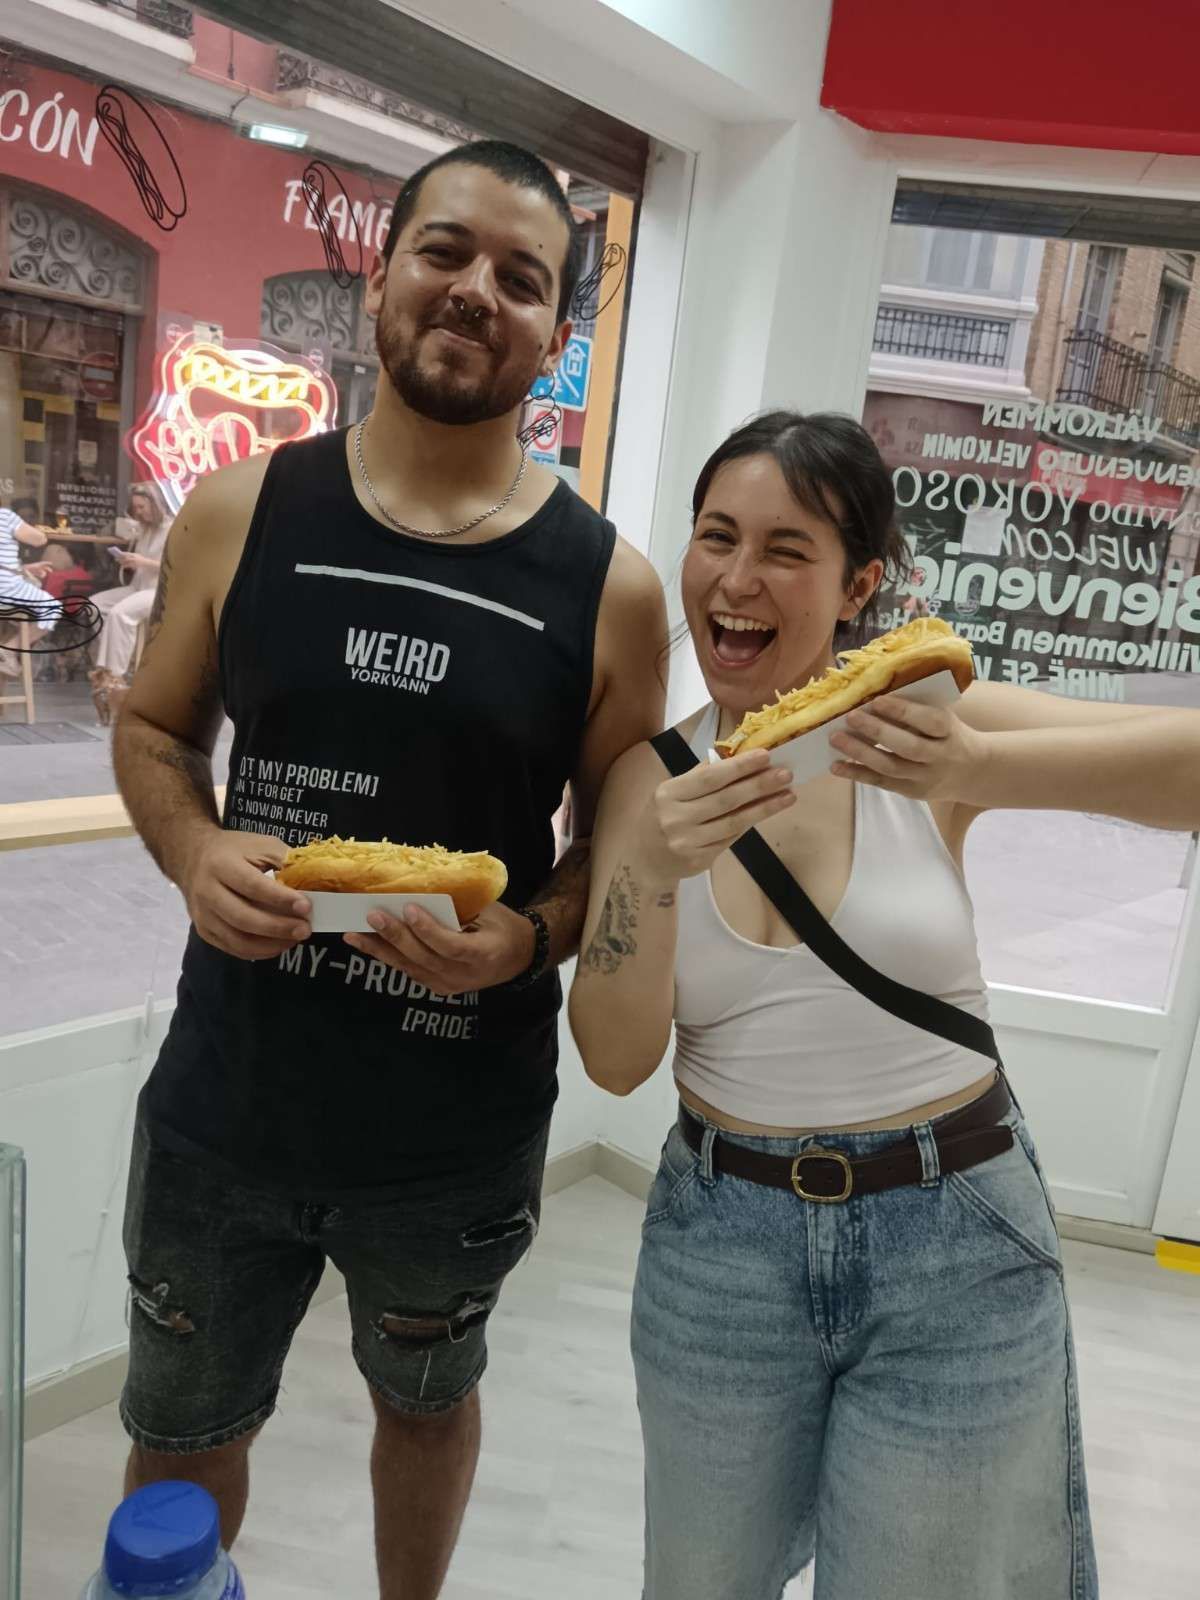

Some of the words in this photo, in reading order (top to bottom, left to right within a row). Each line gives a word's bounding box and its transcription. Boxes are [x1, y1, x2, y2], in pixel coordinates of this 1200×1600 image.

[0, 89, 99, 166] CÓN
[345, 627, 451, 682] WEIRD
[351, 667, 431, 695] YORKVANN
[258, 759, 283, 782] MY
[285, 763, 380, 797] PROBLEM]
[285, 807, 329, 828] NEVER
